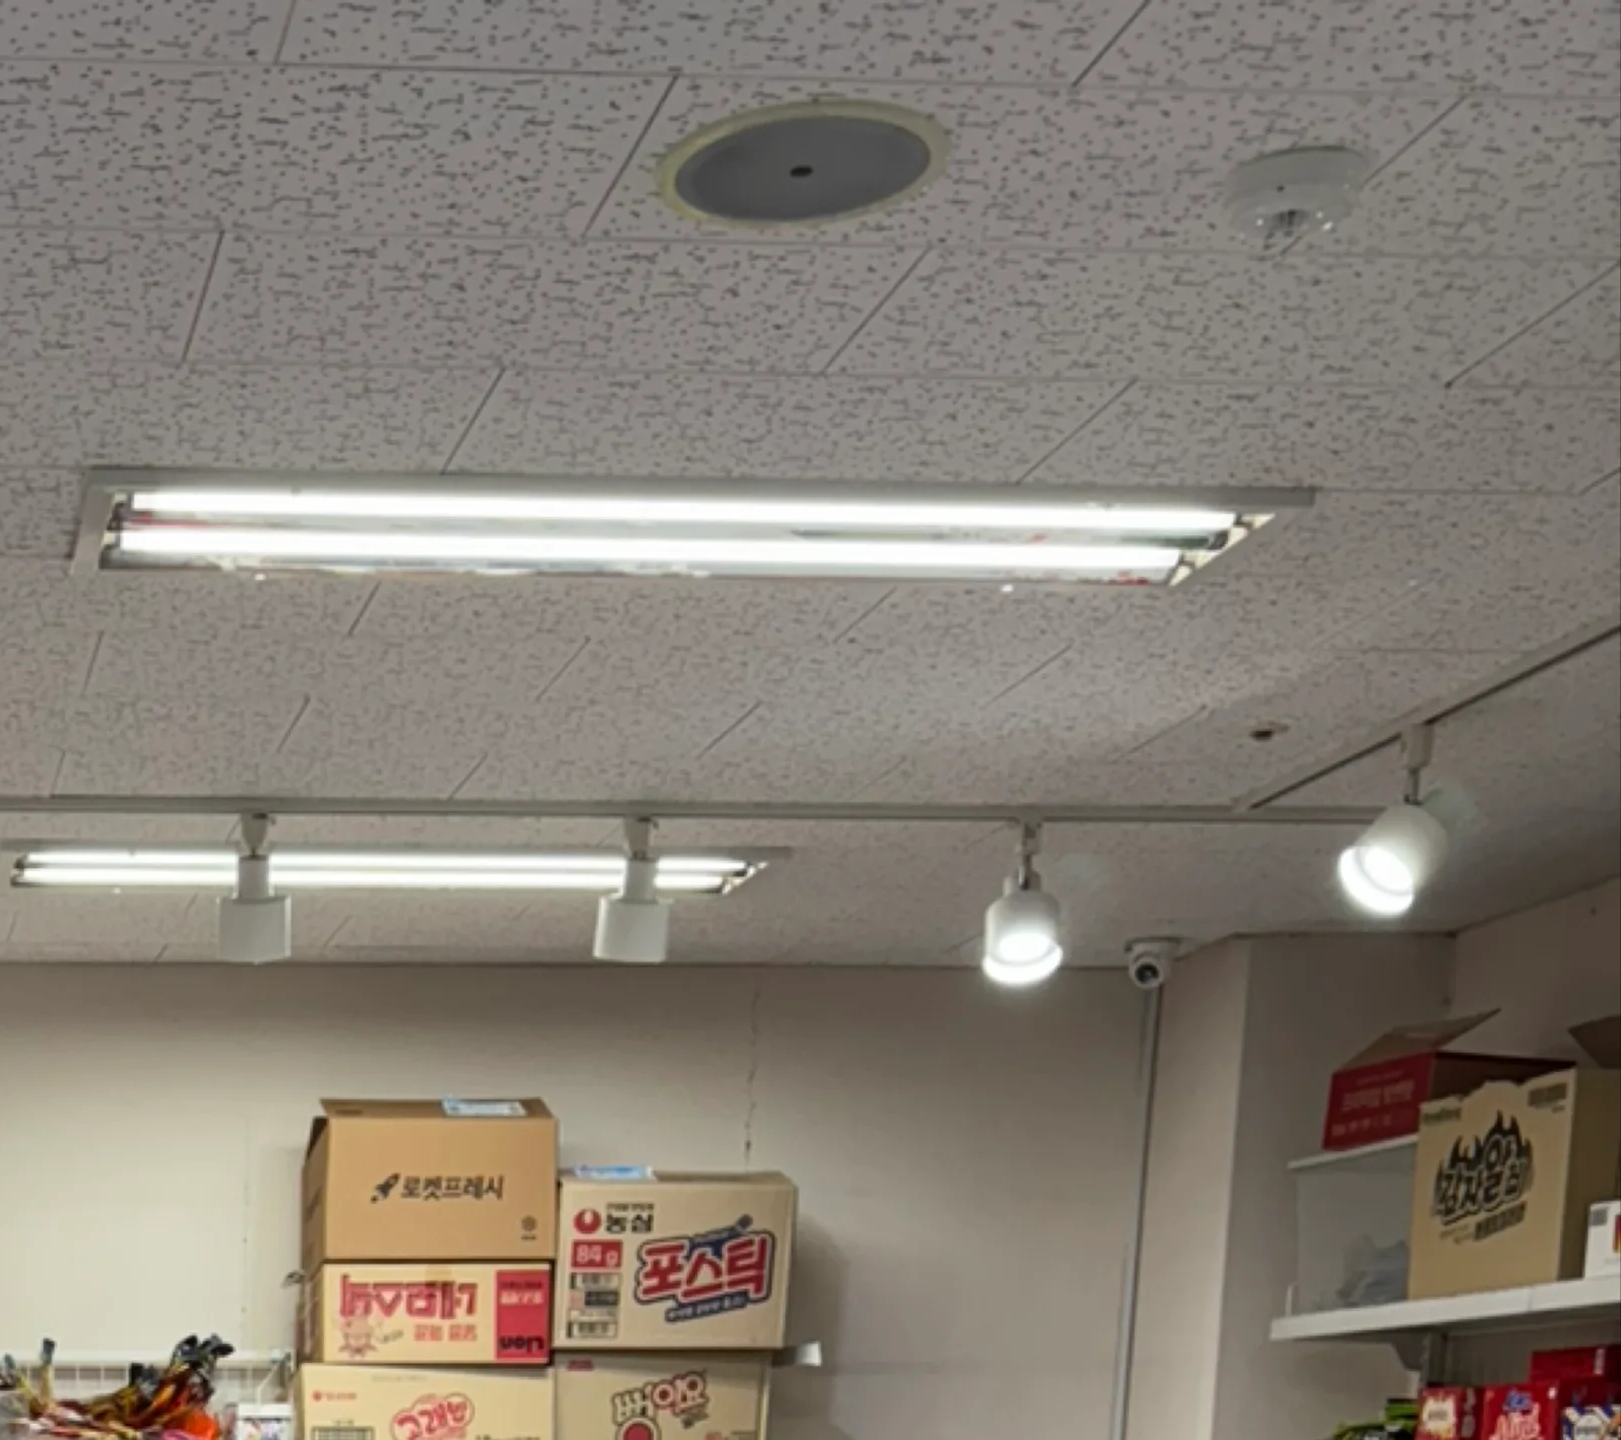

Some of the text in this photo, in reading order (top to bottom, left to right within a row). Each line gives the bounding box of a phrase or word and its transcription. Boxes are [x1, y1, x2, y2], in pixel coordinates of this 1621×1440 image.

[400, 1176, 505, 1200] 로켓프레시
[606, 1214, 655, 1233] 농심
[640, 1236, 769, 1300] 포스틱
